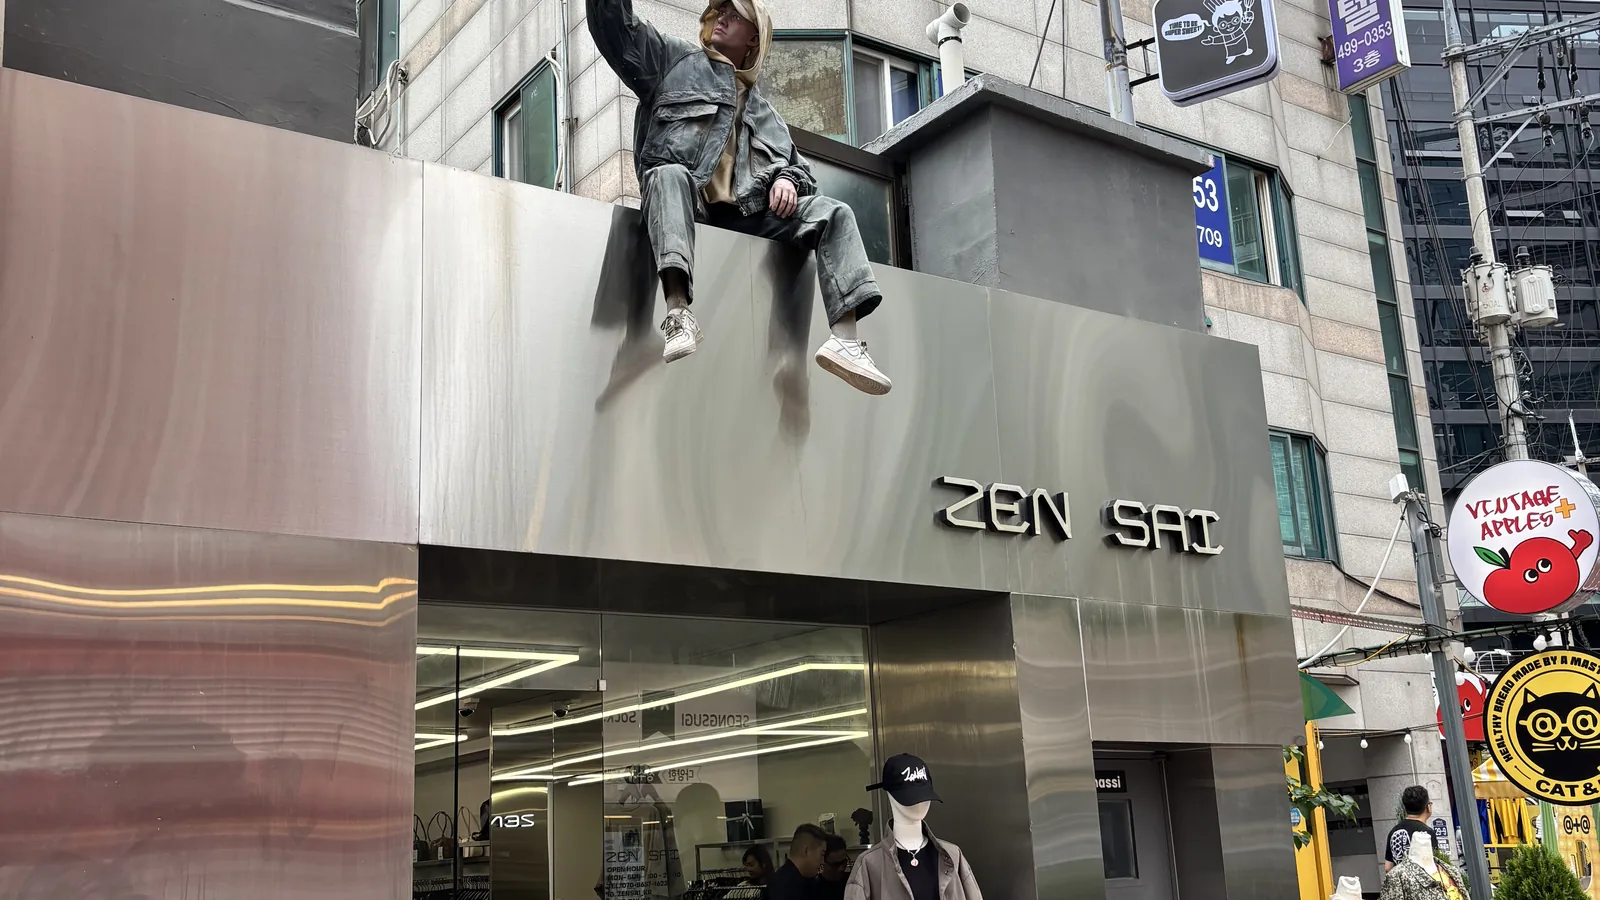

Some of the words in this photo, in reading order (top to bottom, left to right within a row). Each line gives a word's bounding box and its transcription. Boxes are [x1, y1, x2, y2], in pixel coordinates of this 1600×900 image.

[1165, 28, 1181, 36] SUPER
[1183, 20, 1190, 28] TO
[1337, 20, 1393, 59] 499-0353
[1352, 49, 1381, 73] 3층
[1196, 224, 1223, 248] 709
[1465, 485, 1561, 520] VINTAGE
[935, 475, 1073, 540] ZEN
[1107, 498, 1225, 556] SAI
[1481, 510, 1554, 541] APPLES
[1511, 659, 1542, 682] MADE
[1543, 655, 1558, 667] BY
[1560, 655, 1568, 665] A
[1493, 679, 1515, 713] BREAD
[1492, 714, 1514, 763] HEALTHY
[606, 851, 639, 863] ZEN
